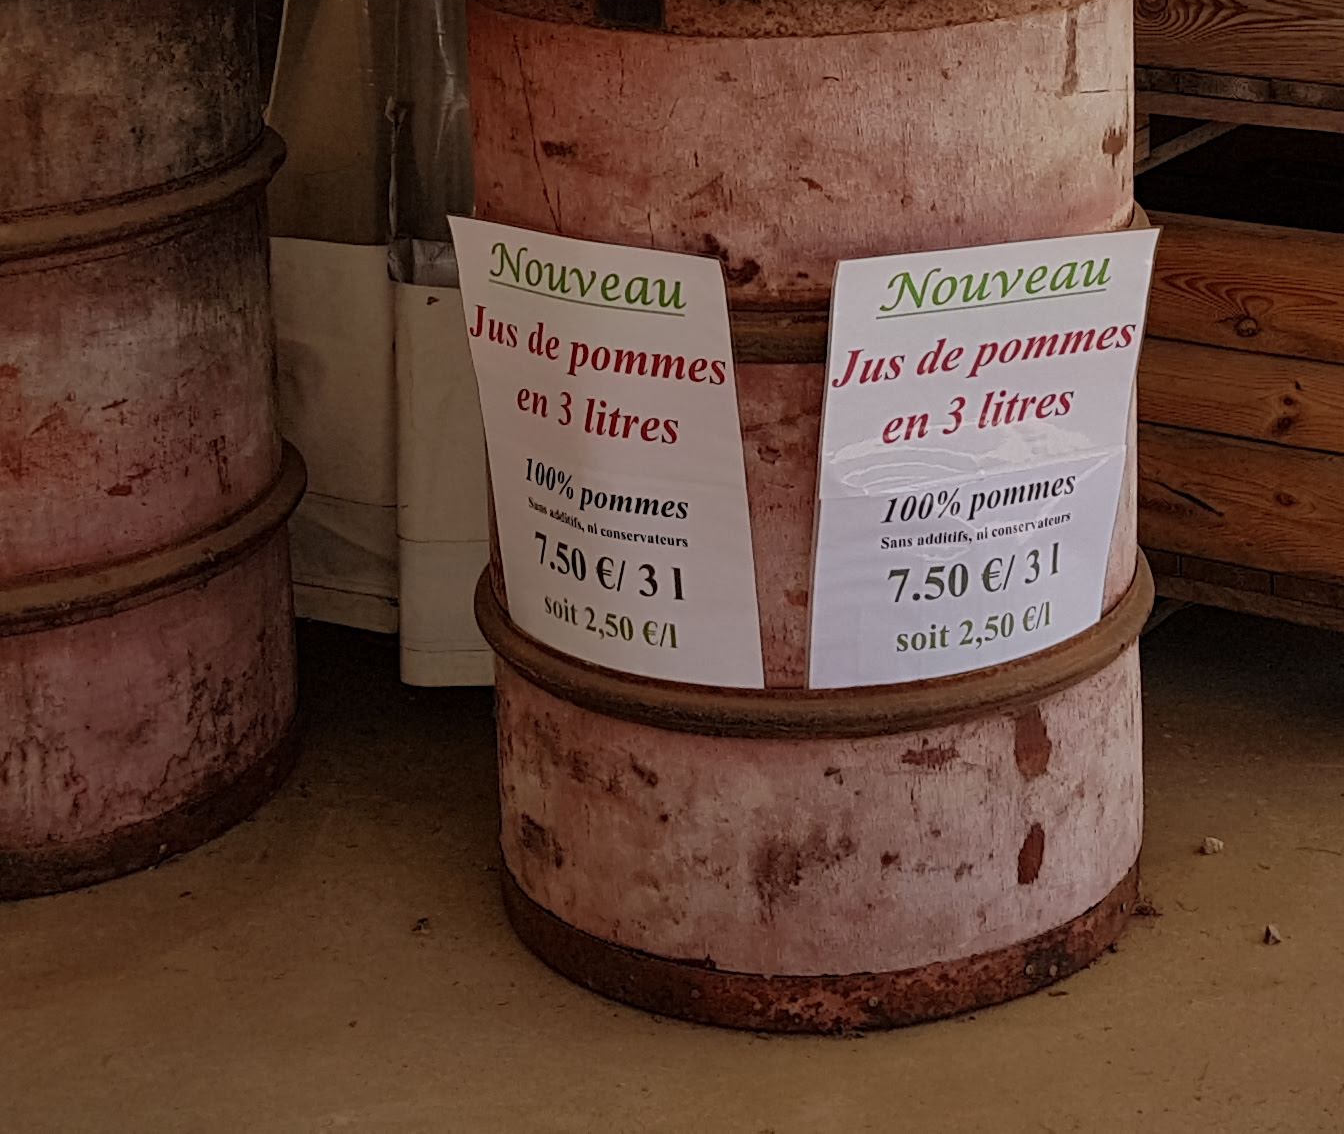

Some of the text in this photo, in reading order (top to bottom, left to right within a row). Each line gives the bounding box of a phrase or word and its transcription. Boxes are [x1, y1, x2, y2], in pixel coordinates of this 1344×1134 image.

[489, 242, 687, 311] Nouveau
[879, 257, 1112, 313] Nouveau
[469, 303, 728, 387] Jus de pommes
[831, 321, 1137, 389] Jus de pommes
[517, 385, 680, 446] en 3 litres
[882, 387, 1075, 445] en 3 litres
[524, 457, 690, 521] 100% pommes
[881, 474, 1077, 525] 100% pommes
[527, 495, 548, 517] Sans
[587, 521, 599, 535] ni
[600, 525, 689, 549] conservateurs
[880, 510, 1072, 550] Sans additifs, ni conservateurs
[534, 530, 587, 583] 7.50
[595, 556, 627, 594] €/
[638, 563, 659, 598] 3
[887, 562, 969, 604] 7.50
[980, 554, 1016, 593] €/
[1025, 548, 1041, 585] 3
[543, 591, 578, 628] soit
[584, 605, 635, 643] 2,50
[895, 625, 950, 653] soit
[959, 610, 1015, 650] 2,50
